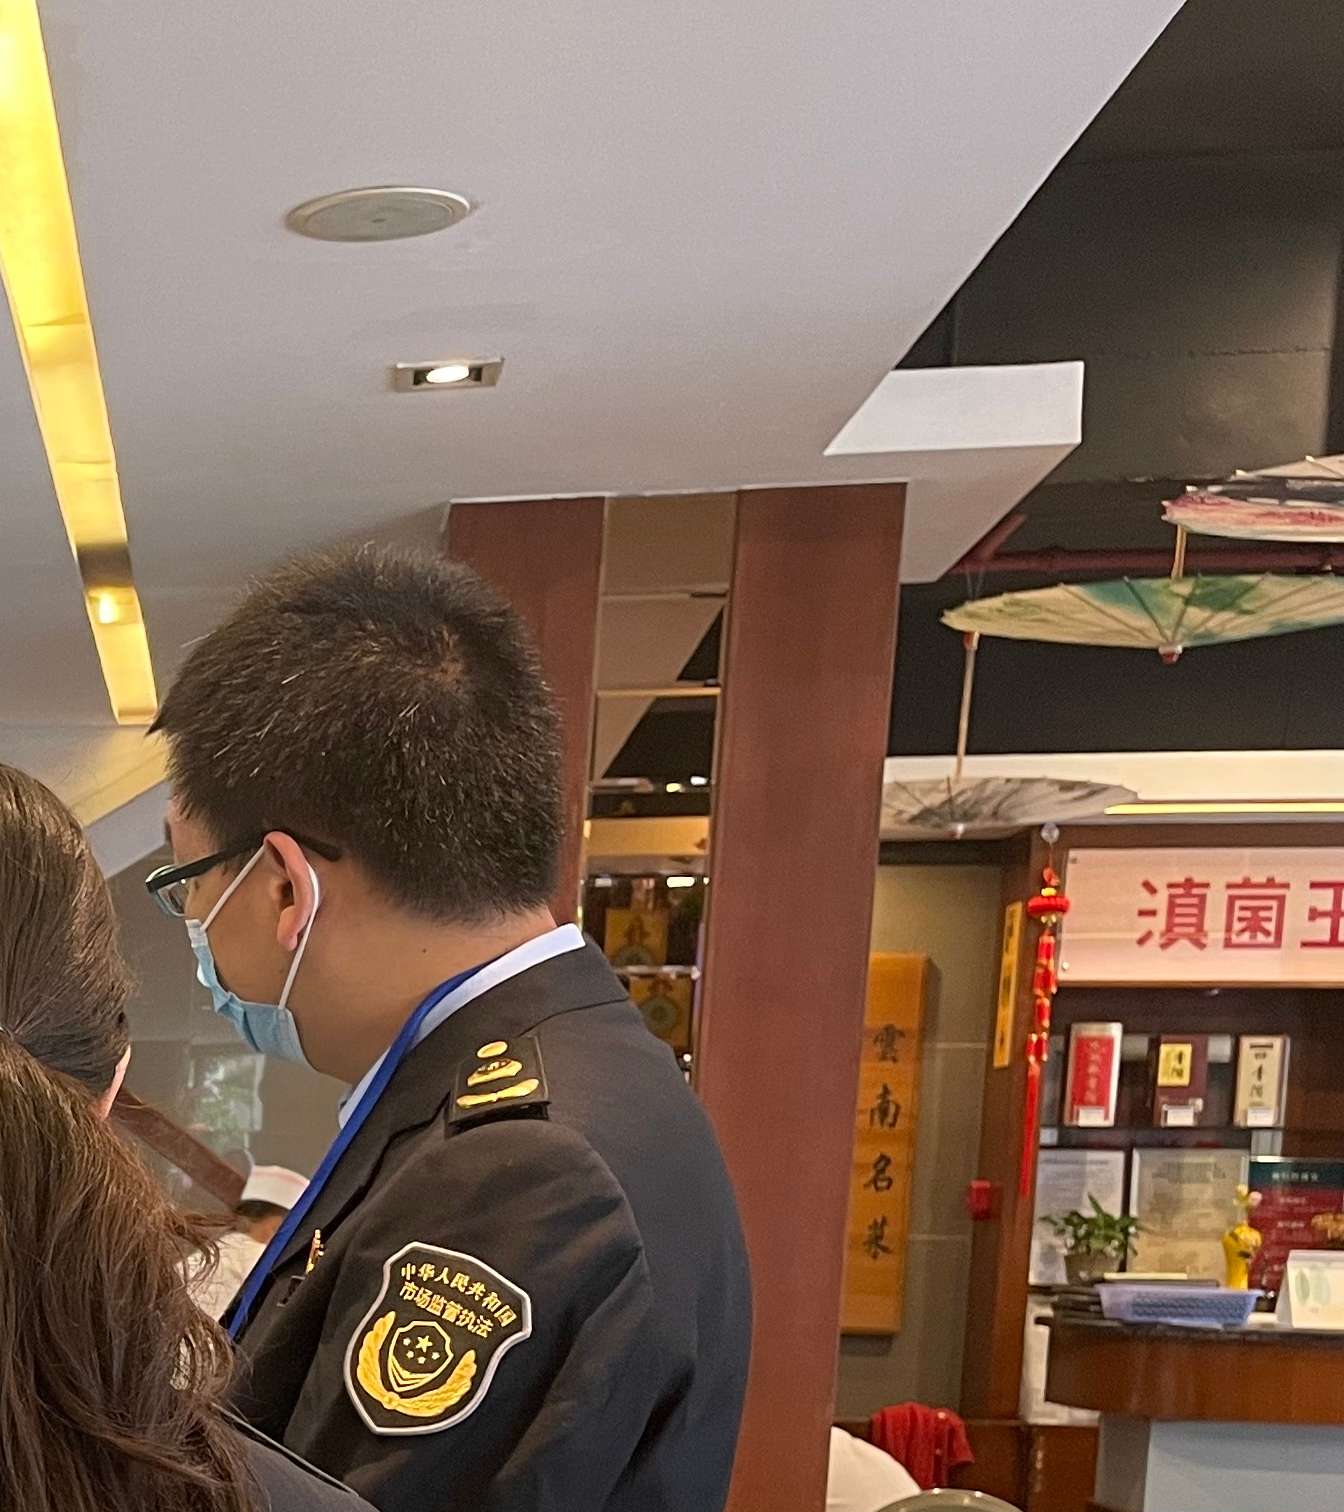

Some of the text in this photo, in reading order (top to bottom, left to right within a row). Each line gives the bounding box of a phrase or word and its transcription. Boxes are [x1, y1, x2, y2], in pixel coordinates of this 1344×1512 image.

[399, 1281, 494, 1338] 市场监管执法
[401, 1262, 518, 1328] 中华人民共和国
